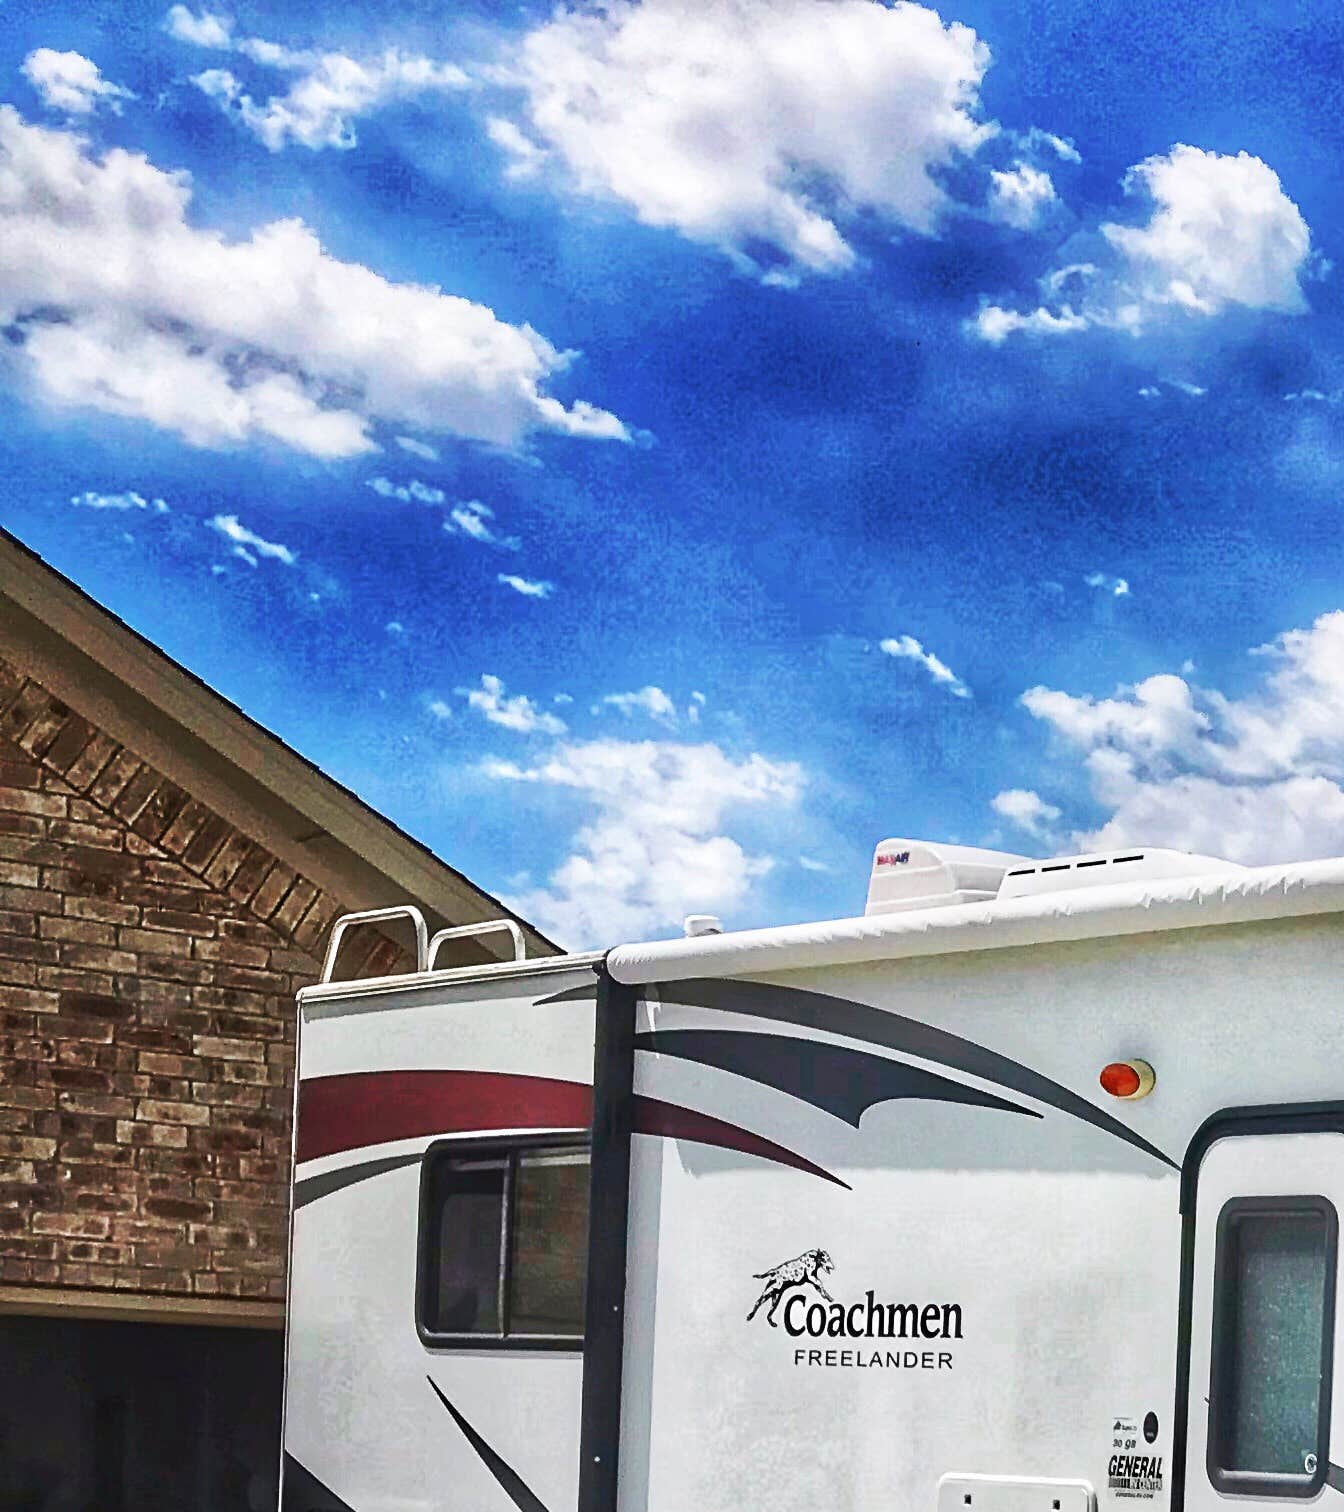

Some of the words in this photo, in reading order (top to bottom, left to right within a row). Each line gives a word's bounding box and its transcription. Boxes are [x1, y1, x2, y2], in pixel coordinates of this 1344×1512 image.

[783, 1290, 963, 1339] Coachmen
[794, 1349, 954, 1370] FREELANDER
[1108, 1455, 1163, 1478] GENERAL
